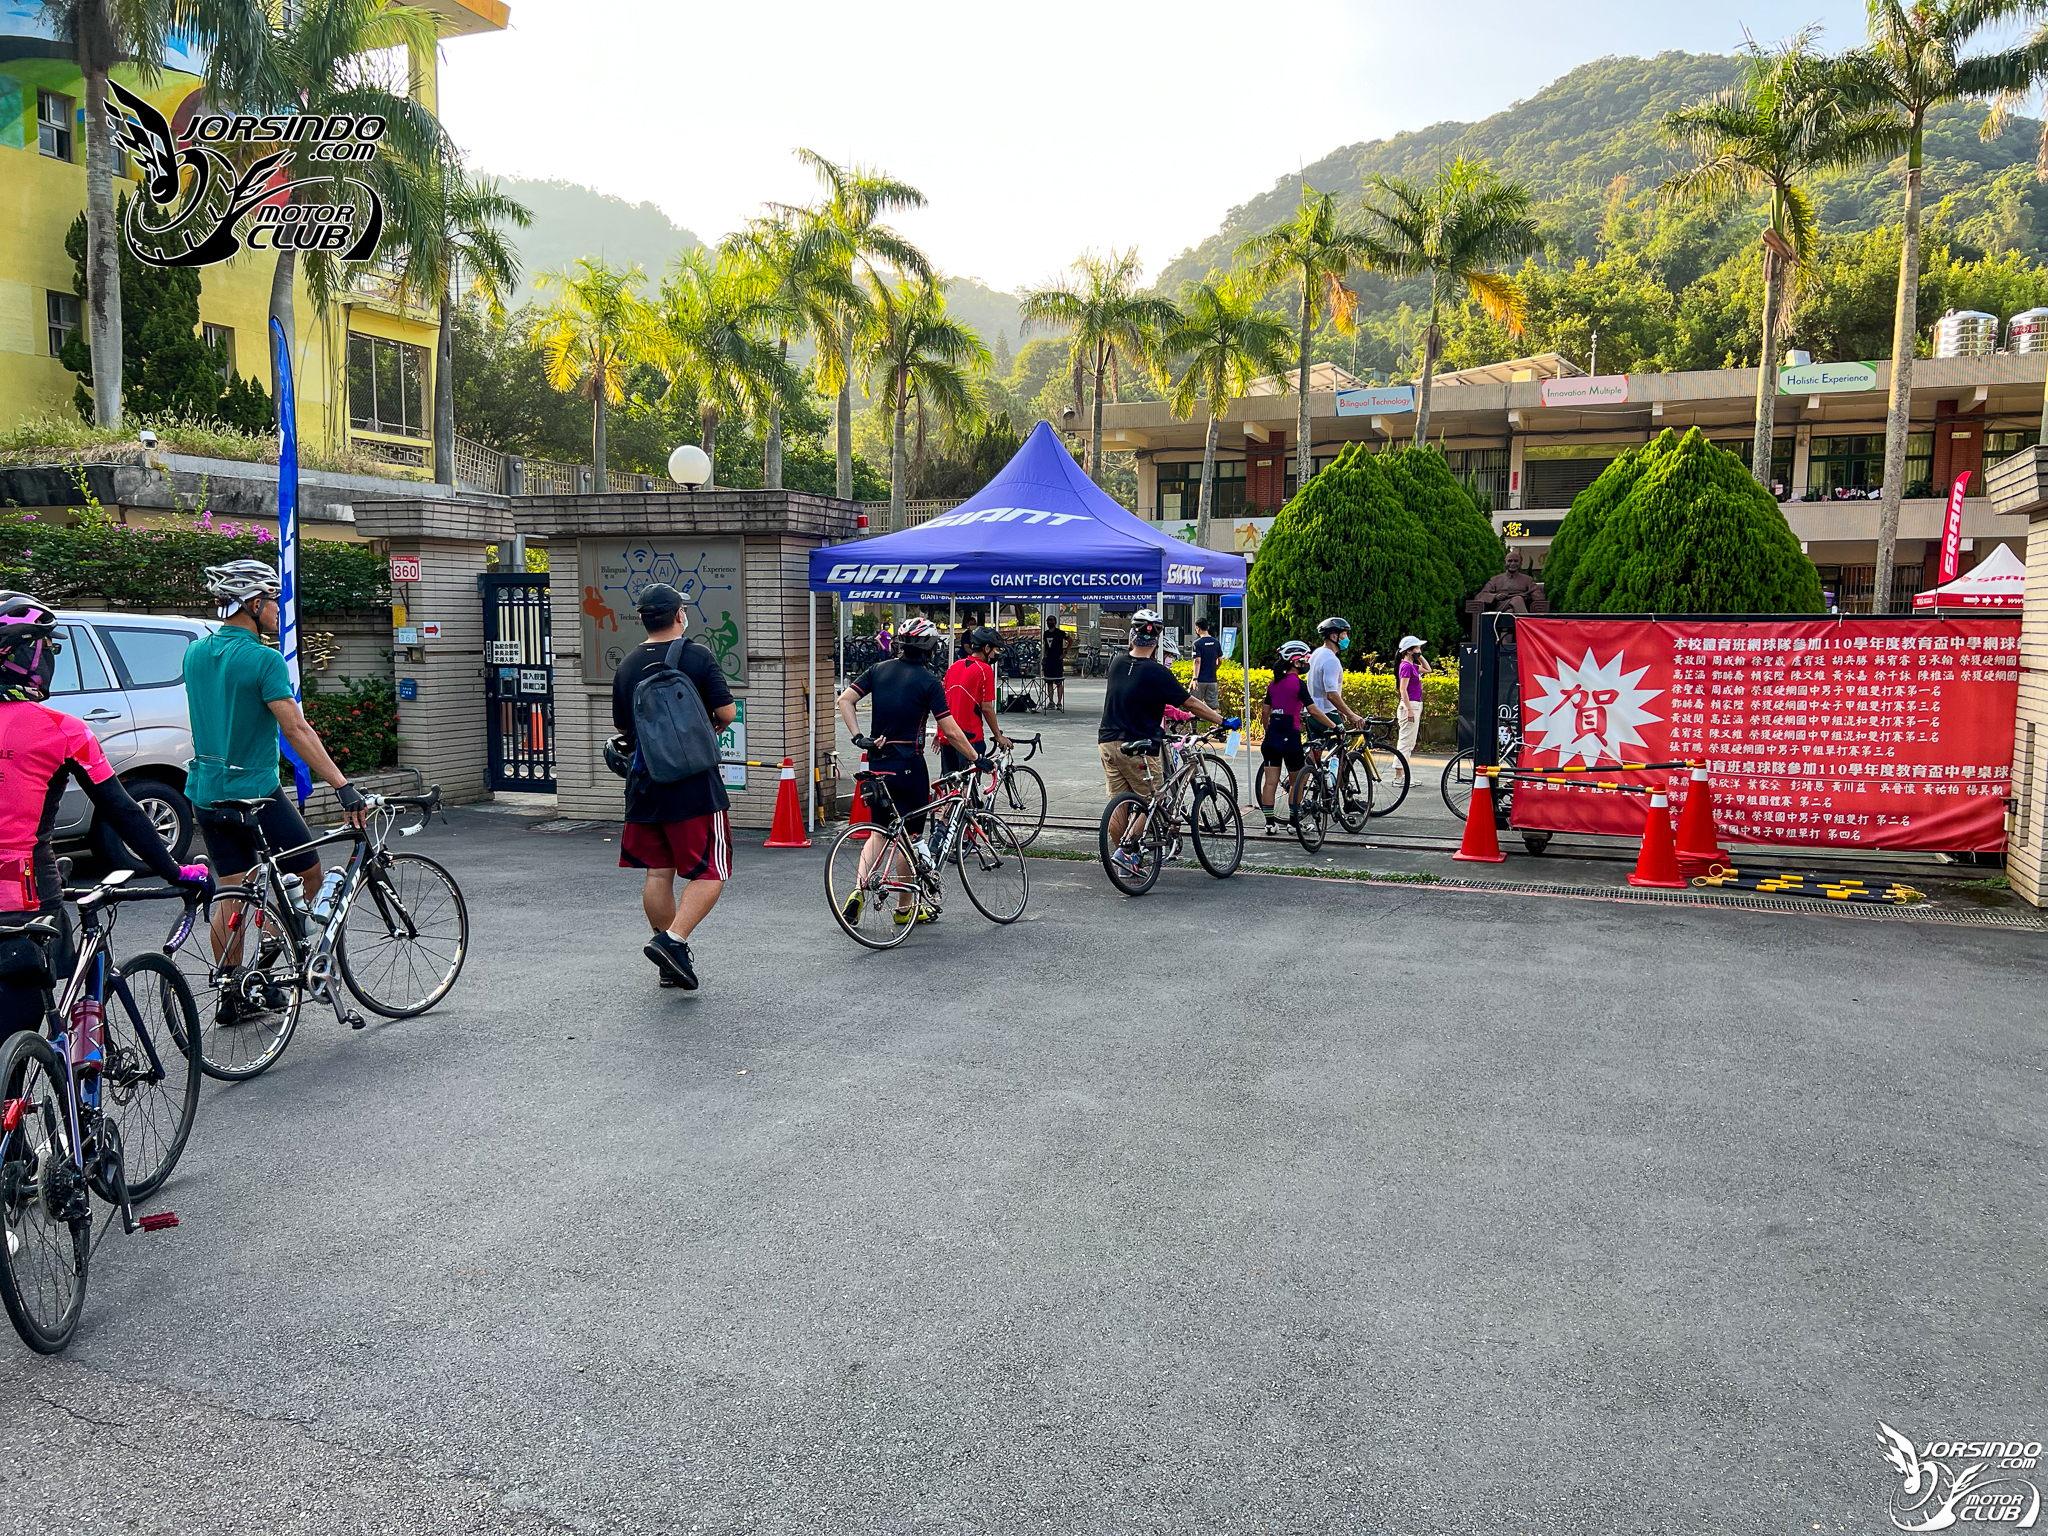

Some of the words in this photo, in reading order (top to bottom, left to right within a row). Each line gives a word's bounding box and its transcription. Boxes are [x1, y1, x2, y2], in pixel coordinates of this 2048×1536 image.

[1787, 374, 1819, 386] Holistic
[1821, 371, 1869, 385] Experience
[1547, 387, 1587, 398] Innovation
[1588, 385, 1622, 397] Multiple
[1339, 398, 1370, 409] Bilingual
[1371, 396, 1411, 407] Technology
[912, 507, 1094, 531] GIANT
[1944, 481, 1964, 576] SRAM
[394, 565, 417, 577] 360
[601, 566, 628, 577] Bilingual
[659, 567, 669, 576] AI
[702, 565, 736, 575] Experience
[827, 564, 960, 583] GIANT
[1167, 564, 1205, 585] GIANT
[991, 573, 1143, 586] GIANT-BICYCLES.COM
[400, 633, 417, 643] 360
[302, 631, 341, 671] 學
[1790, 670, 1826, 682] 陳又維
[1832, 669, 1868, 682] 黃永嘉
[1751, 685, 1942, 697] 榮獲硬網國中男子甲組雙打賽第一名
[1750, 699, 1941, 712] 榮獲硬網國中女子甲組雙打賽第三名
[1548, 684, 1621, 748] 賀
[1749, 714, 1941, 728] 榮獲硬網國中甲組混和雙打賽第一名
[1709, 728, 1743, 740] 陳又維
[1748, 729, 1940, 743] 榮獲硬網國中甲組混和雙打賽第三名
[1669, 741, 1703, 754] 張育鵬
[1708, 743, 1896, 757] 榮獲硬網國中男子甲組單打賽第三名
[1668, 790, 1793, 807] 榮獲男子甲組團體賽
[1799, 796, 1833, 808] 第二名
[1751, 810, 1870, 826] 榮獲國中男子甲組雙打
[1876, 813, 1911, 827] 第二名
[1715, 823, 1821, 840] 獲國中男子甲組單打
[1827, 829, 1861, 841] 第四名
